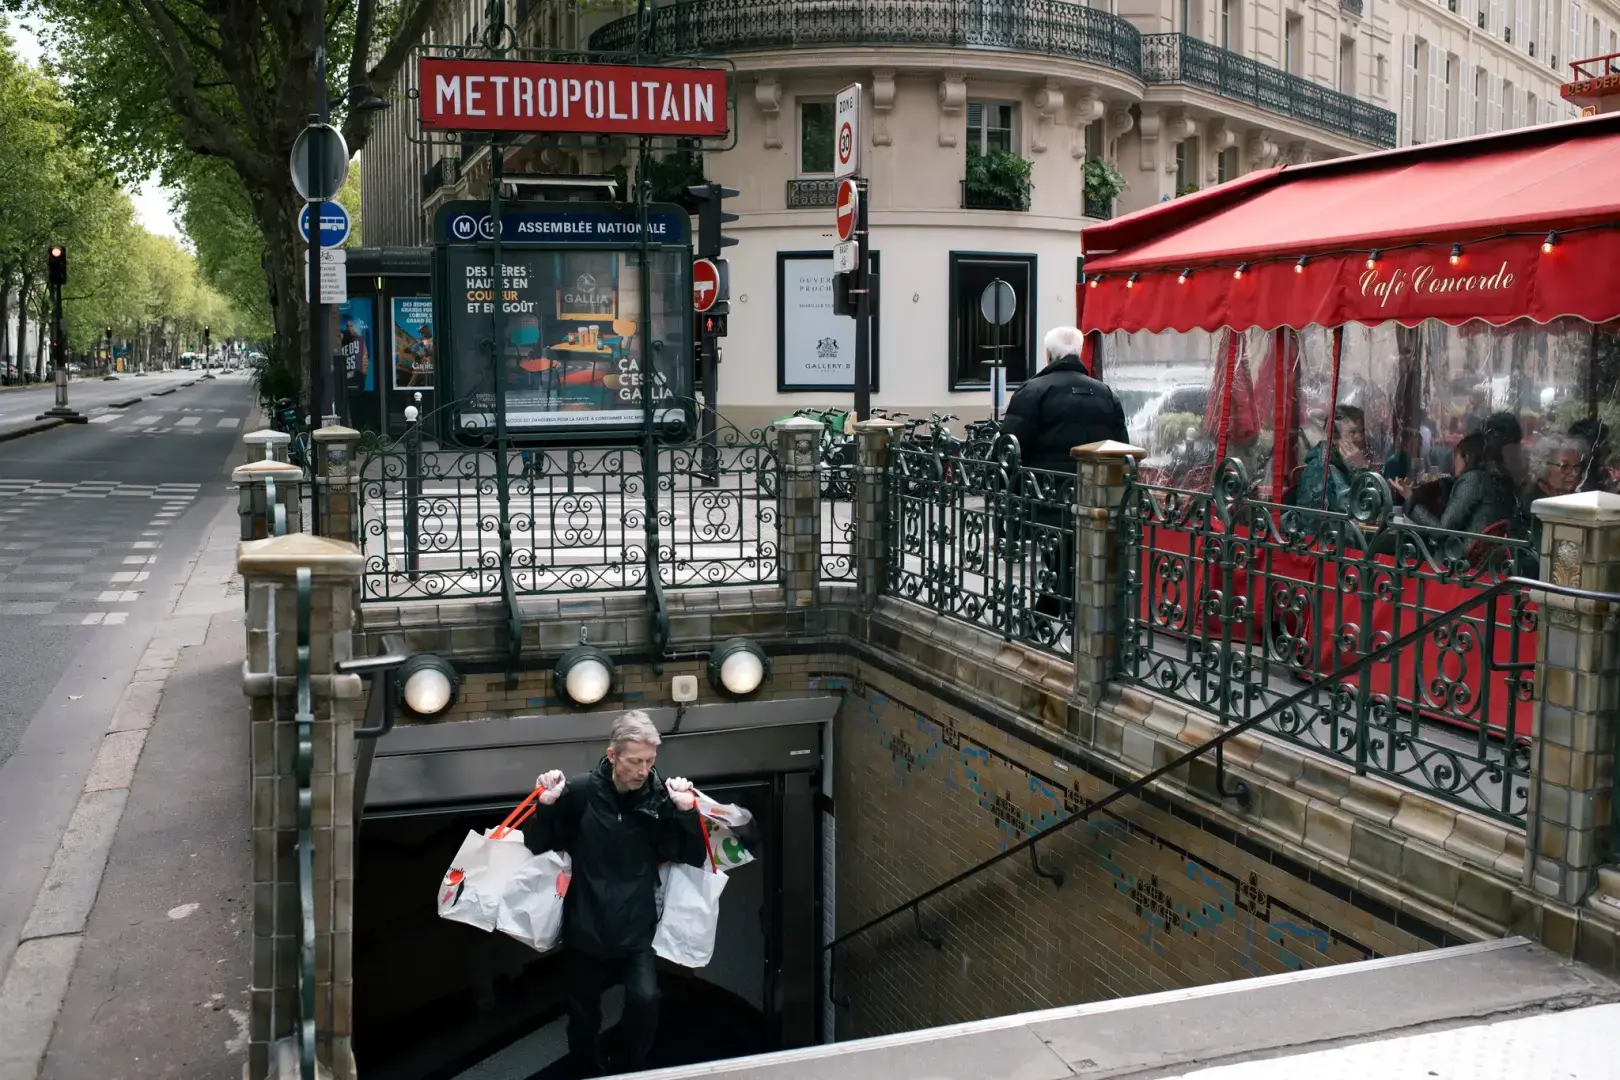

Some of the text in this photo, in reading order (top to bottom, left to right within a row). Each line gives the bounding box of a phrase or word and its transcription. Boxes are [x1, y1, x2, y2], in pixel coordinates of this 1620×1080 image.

[1595, 76, 1620, 90] DEP
[435, 74, 714, 122] METROPOLITAIN
[839, 96, 853, 114] ZONE
[841, 133, 850, 153] 30
[460, 221, 470, 233] M
[517, 220, 593, 233] ASSEMBLÉE
[466, 265, 488, 277] DES
[466, 278, 528, 289] HAUTS EN
[1358, 260, 1516, 308] Café Concorde
[466, 290, 519, 301] COUUR
[564, 293, 609, 304] GALLIA
[467, 302, 480, 313] ET
[502, 300, 534, 313] GOÛT
[618, 358, 640, 374] ÇA
[619, 387, 673, 400] GALIA
